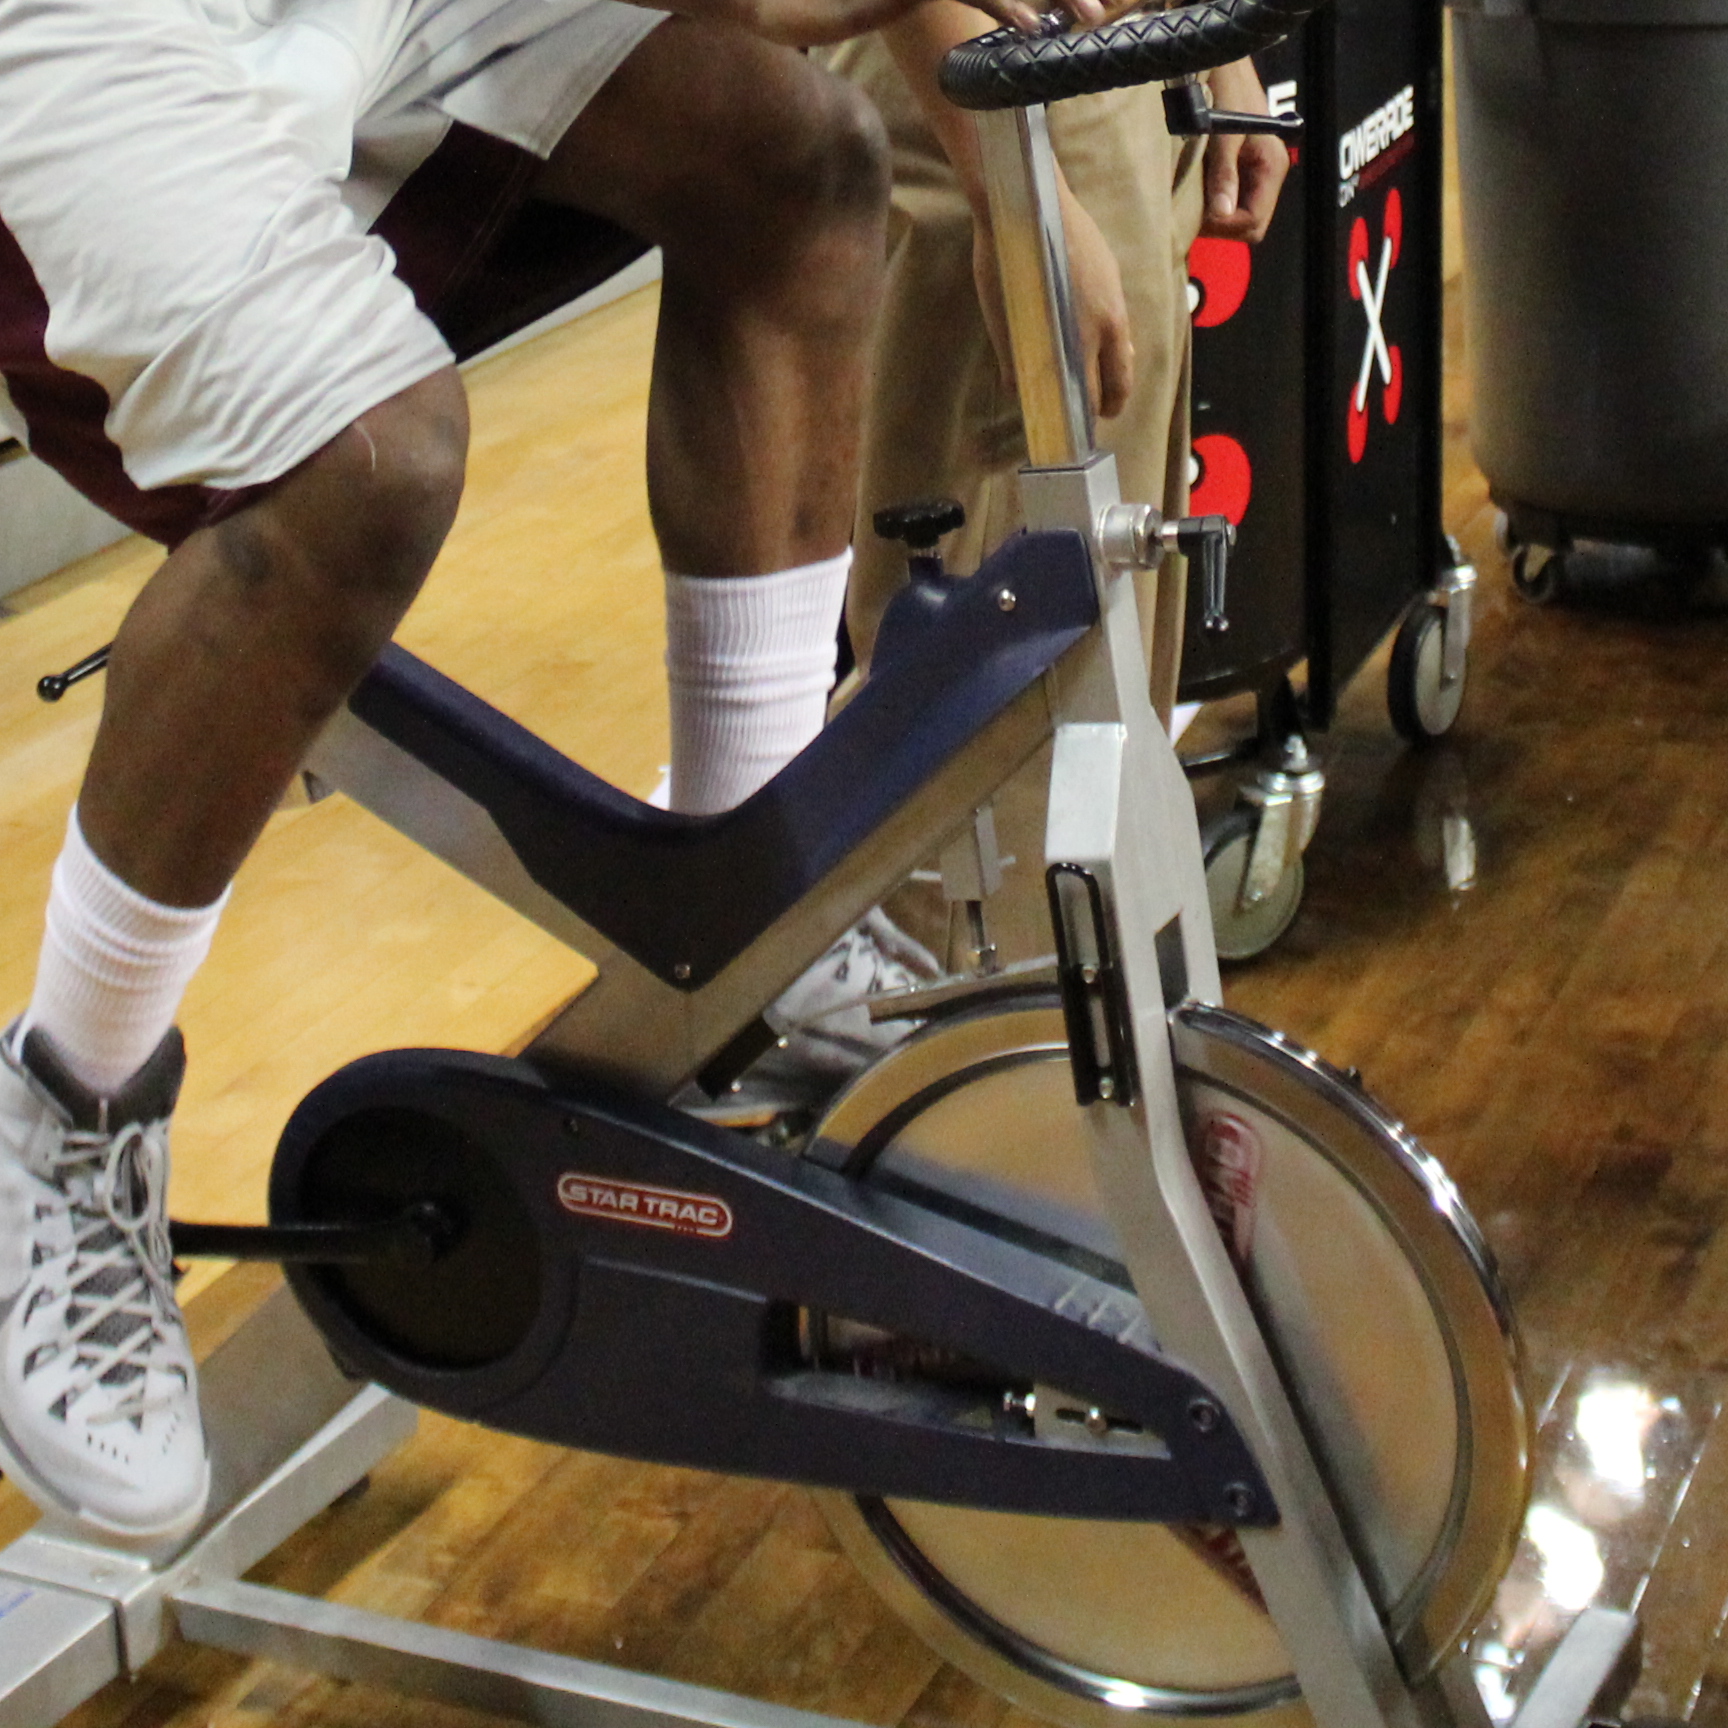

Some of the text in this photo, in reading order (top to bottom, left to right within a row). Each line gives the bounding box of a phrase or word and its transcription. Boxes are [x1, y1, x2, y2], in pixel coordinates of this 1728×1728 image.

[1338, 83, 1415, 181] OWERADE
[569, 1184, 719, 1226] STAR TRAC
